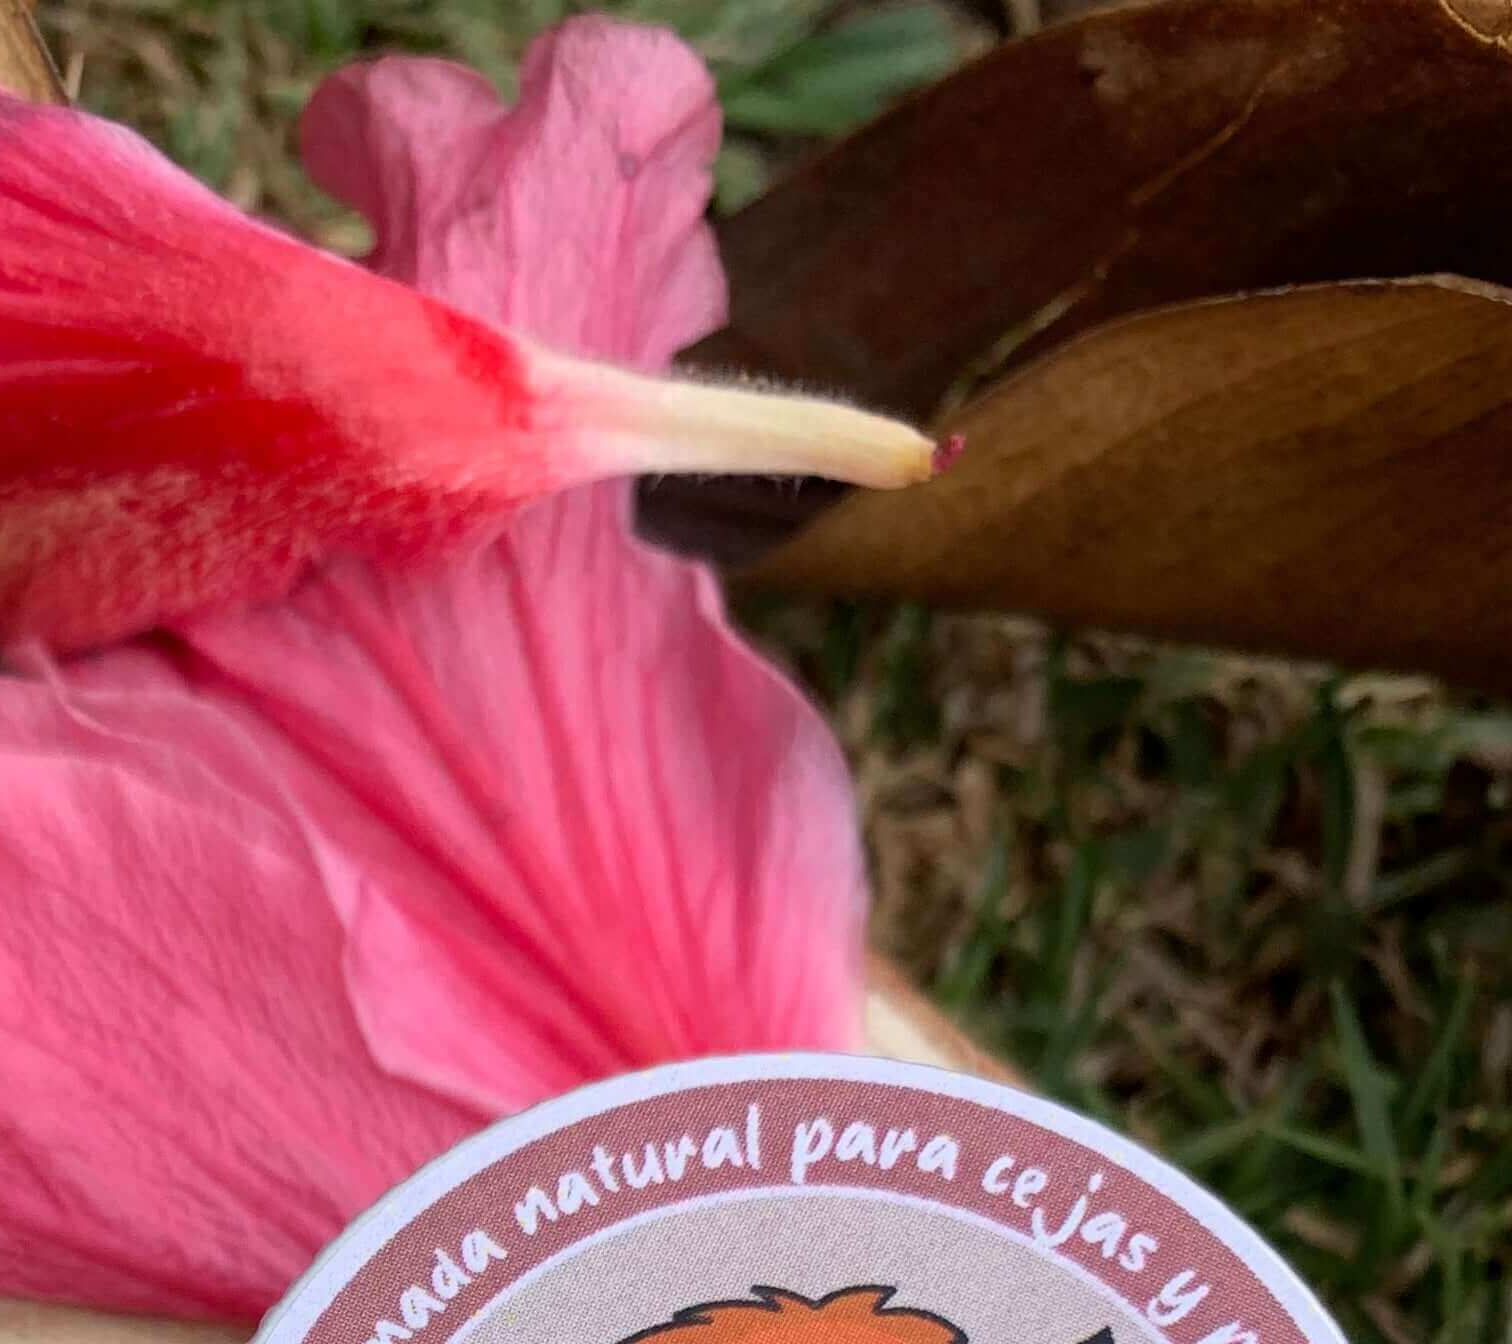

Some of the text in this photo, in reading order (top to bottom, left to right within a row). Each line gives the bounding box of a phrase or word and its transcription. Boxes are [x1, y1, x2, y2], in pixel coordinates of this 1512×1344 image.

[514, 1103, 760, 1235] natural
[789, 1116, 957, 1185] para
[1148, 1268, 1208, 1328] y
